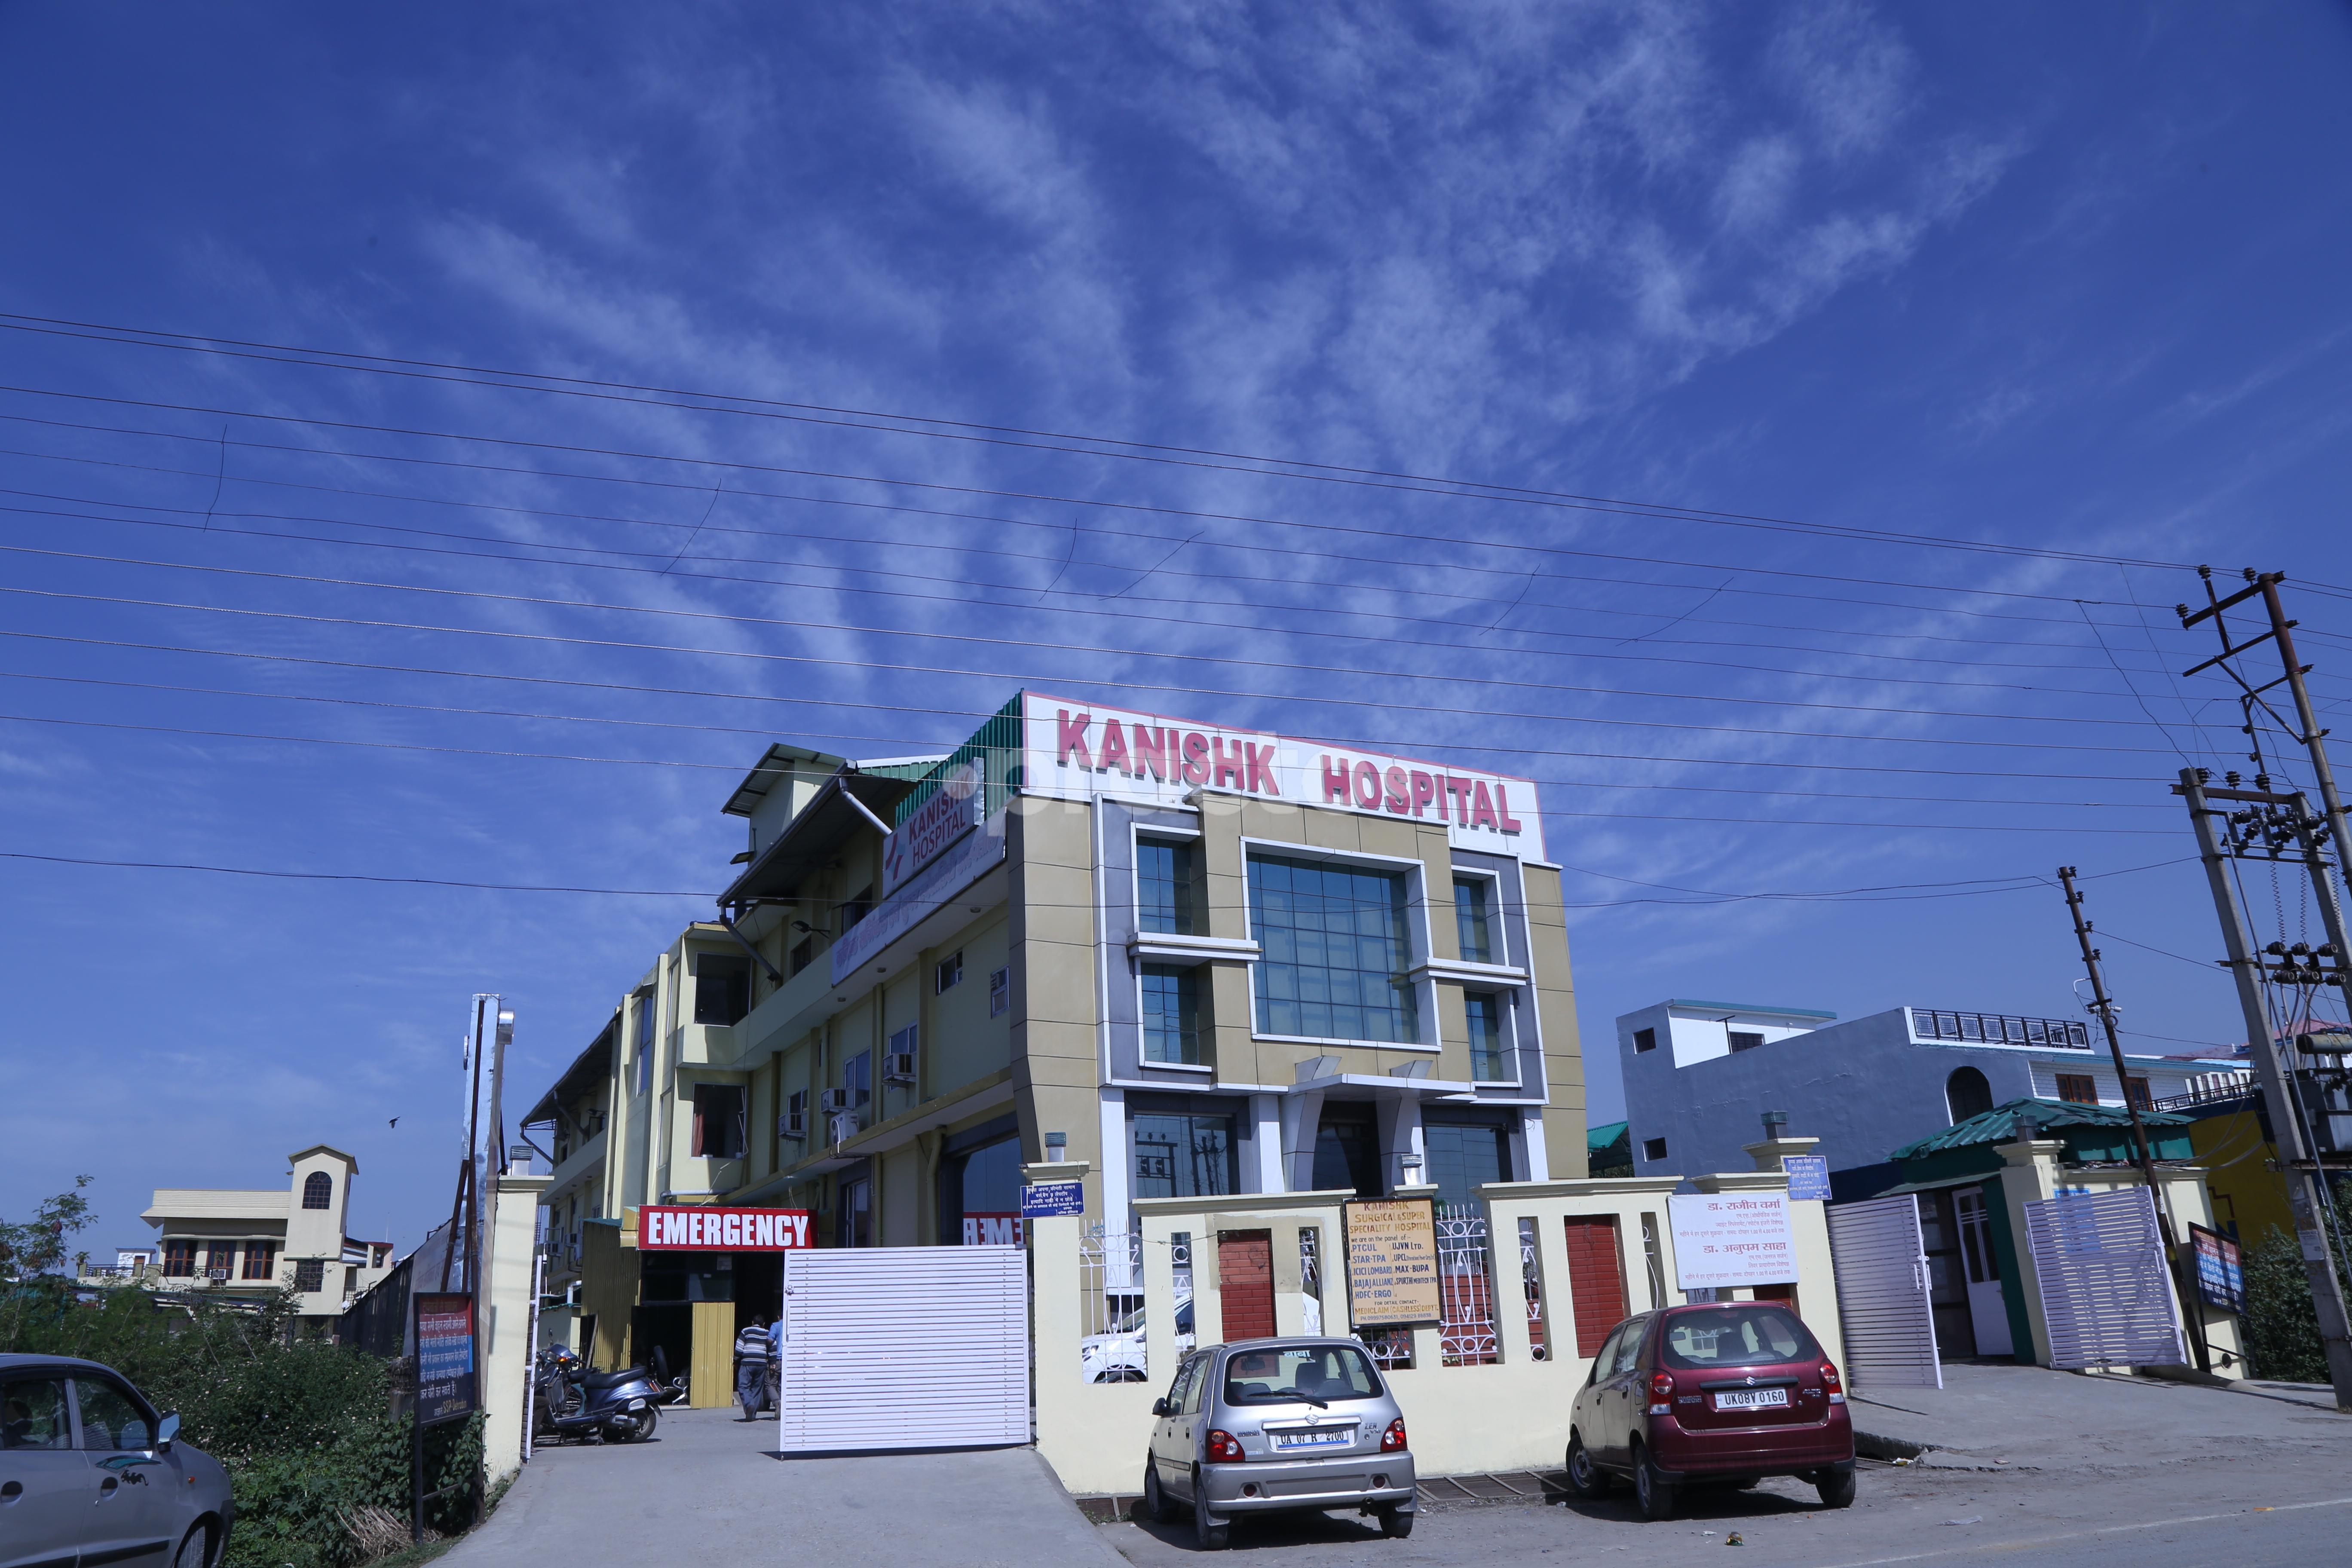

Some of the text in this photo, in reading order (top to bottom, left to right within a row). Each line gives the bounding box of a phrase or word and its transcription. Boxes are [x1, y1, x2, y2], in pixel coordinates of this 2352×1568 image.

[1057, 709, 1521, 834] KANISHK HOSPITAL
[910, 771, 971, 845] KANISHK
[913, 806, 966, 867] HOSPITAL
[1364, 1201, 1409, 1211] KANISHK
[1707, 1199, 1781, 1211] डा. राजीव वर्मा
[1355, 1213, 1396, 1223] SURGICAL
[1402, 1212, 1425, 1221] SUPER
[648, 1212, 809, 1246] EMERGENCY
[1349, 1222, 1431, 1234] SPECIALITY HOSPITAL
[1384, 1234, 1398, 1243] panel
[1352, 1244, 1377, 1253] PTCUL
[1393, 1242, 1409, 1250] UJVN
[1703, 1242, 1786, 1254] डा. अनुपम साहा
[1354, 1266, 1392, 1276] ICICI LOMBARD
[1354, 1278, 1393, 1289] BAJAJ ALLIANZ
[1759, 1391, 1785, 1403] 0160
[1280, 1430, 1344, 1445] UA 07 R 2700
